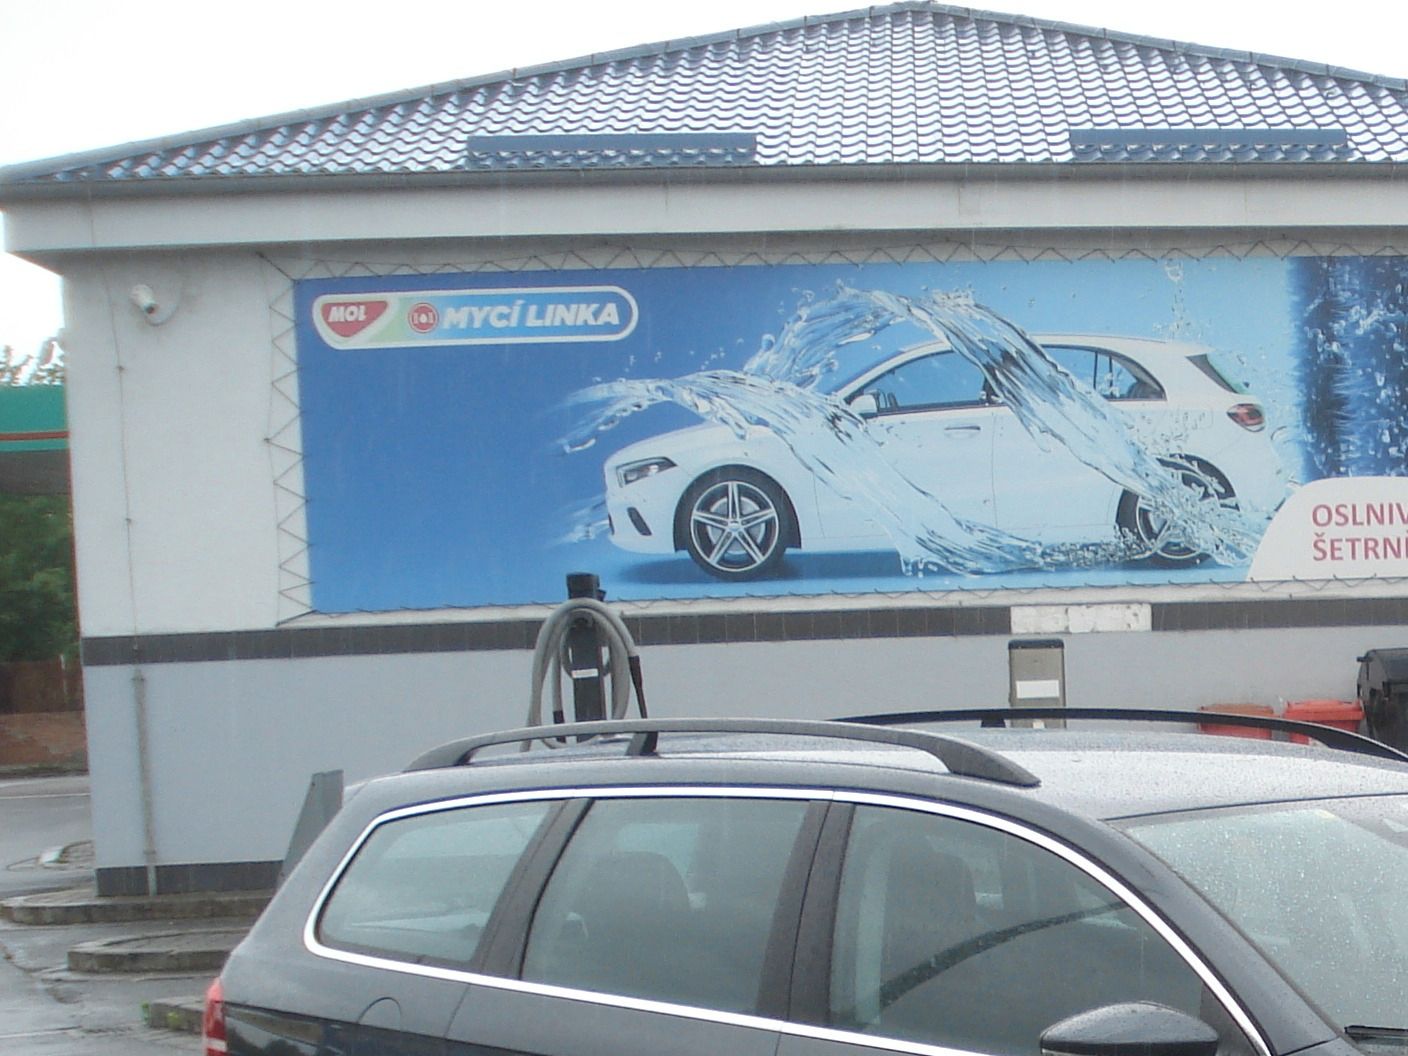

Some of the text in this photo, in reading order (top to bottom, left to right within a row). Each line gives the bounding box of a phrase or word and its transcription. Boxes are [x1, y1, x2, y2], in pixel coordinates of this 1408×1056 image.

[328, 305, 367, 322] MOL
[443, 300, 620, 329] MYCÍ LINKA
